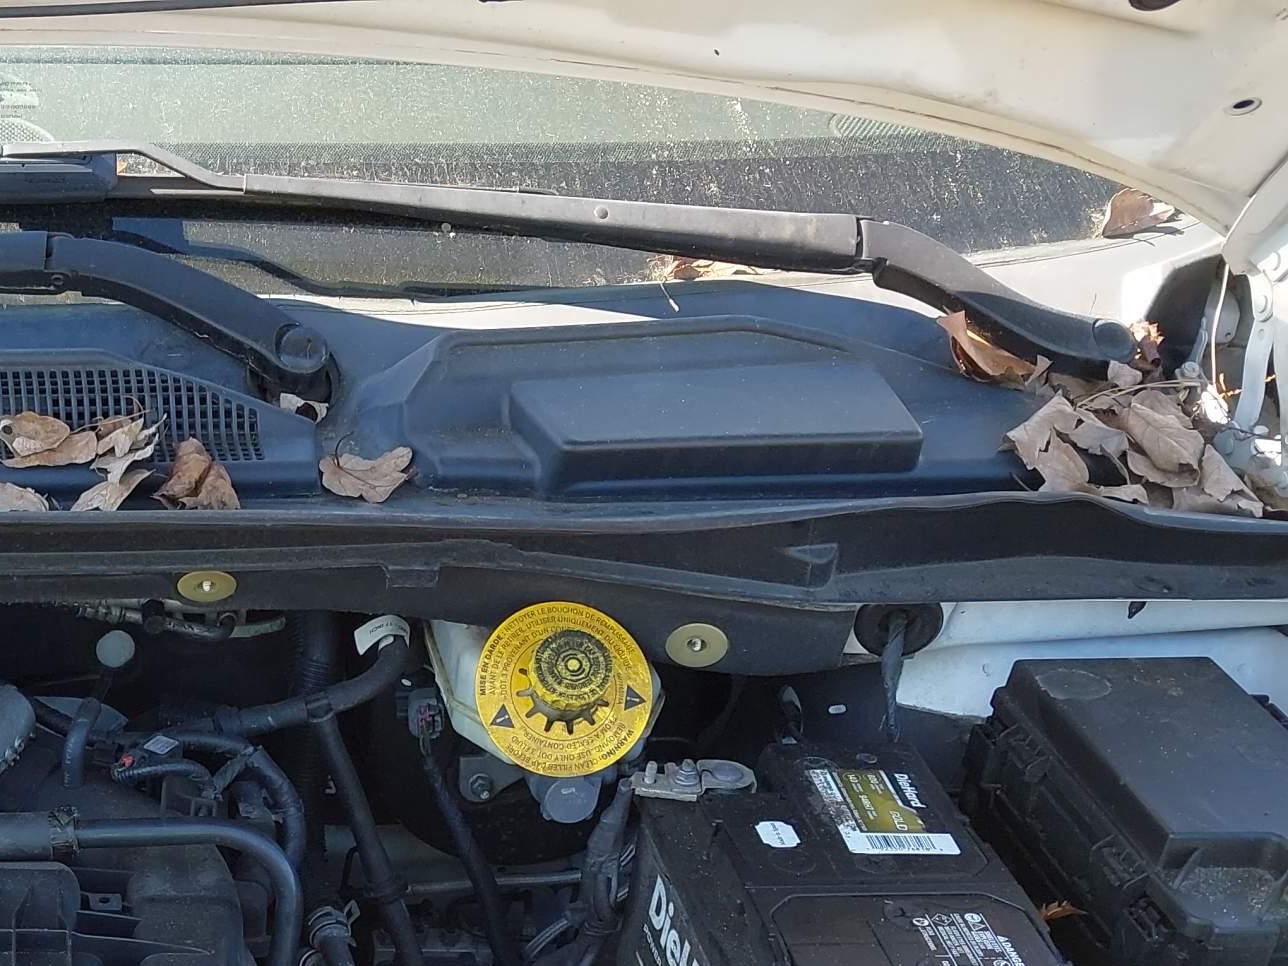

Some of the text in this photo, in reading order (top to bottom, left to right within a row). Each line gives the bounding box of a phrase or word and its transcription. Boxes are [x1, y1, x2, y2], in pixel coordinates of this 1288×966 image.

[536, 607, 546, 616] LE
[546, 604, 585, 614] BOUCHON
[584, 611, 597, 621] DE
[502, 608, 536, 634] NETTOYER
[524, 613, 556, 632] UTILISER
[556, 615, 606, 636] UNIQUEMENT
[603, 632, 615, 645] DU
[495, 649, 505, 659] LE
[501, 634, 532, 672] PROVENANT
[480, 660, 489, 673] EN
[491, 658, 501, 670] DE
[477, 673, 487, 695] MISE
[487, 670, 497, 696] AVANT
[499, 679, 507, 695] DOT
[503, 727, 635, 772] WARNING: CLEAN FILLER CAP BEFORE
[509, 733, 531, 753] FLUID
[536, 749, 553, 761] DOT
[553, 753, 575, 762] ONLY
[575, 748, 592, 761] USE
[894, 773, 926, 809] DieHard
[889, 810, 908, 831] GOLD
